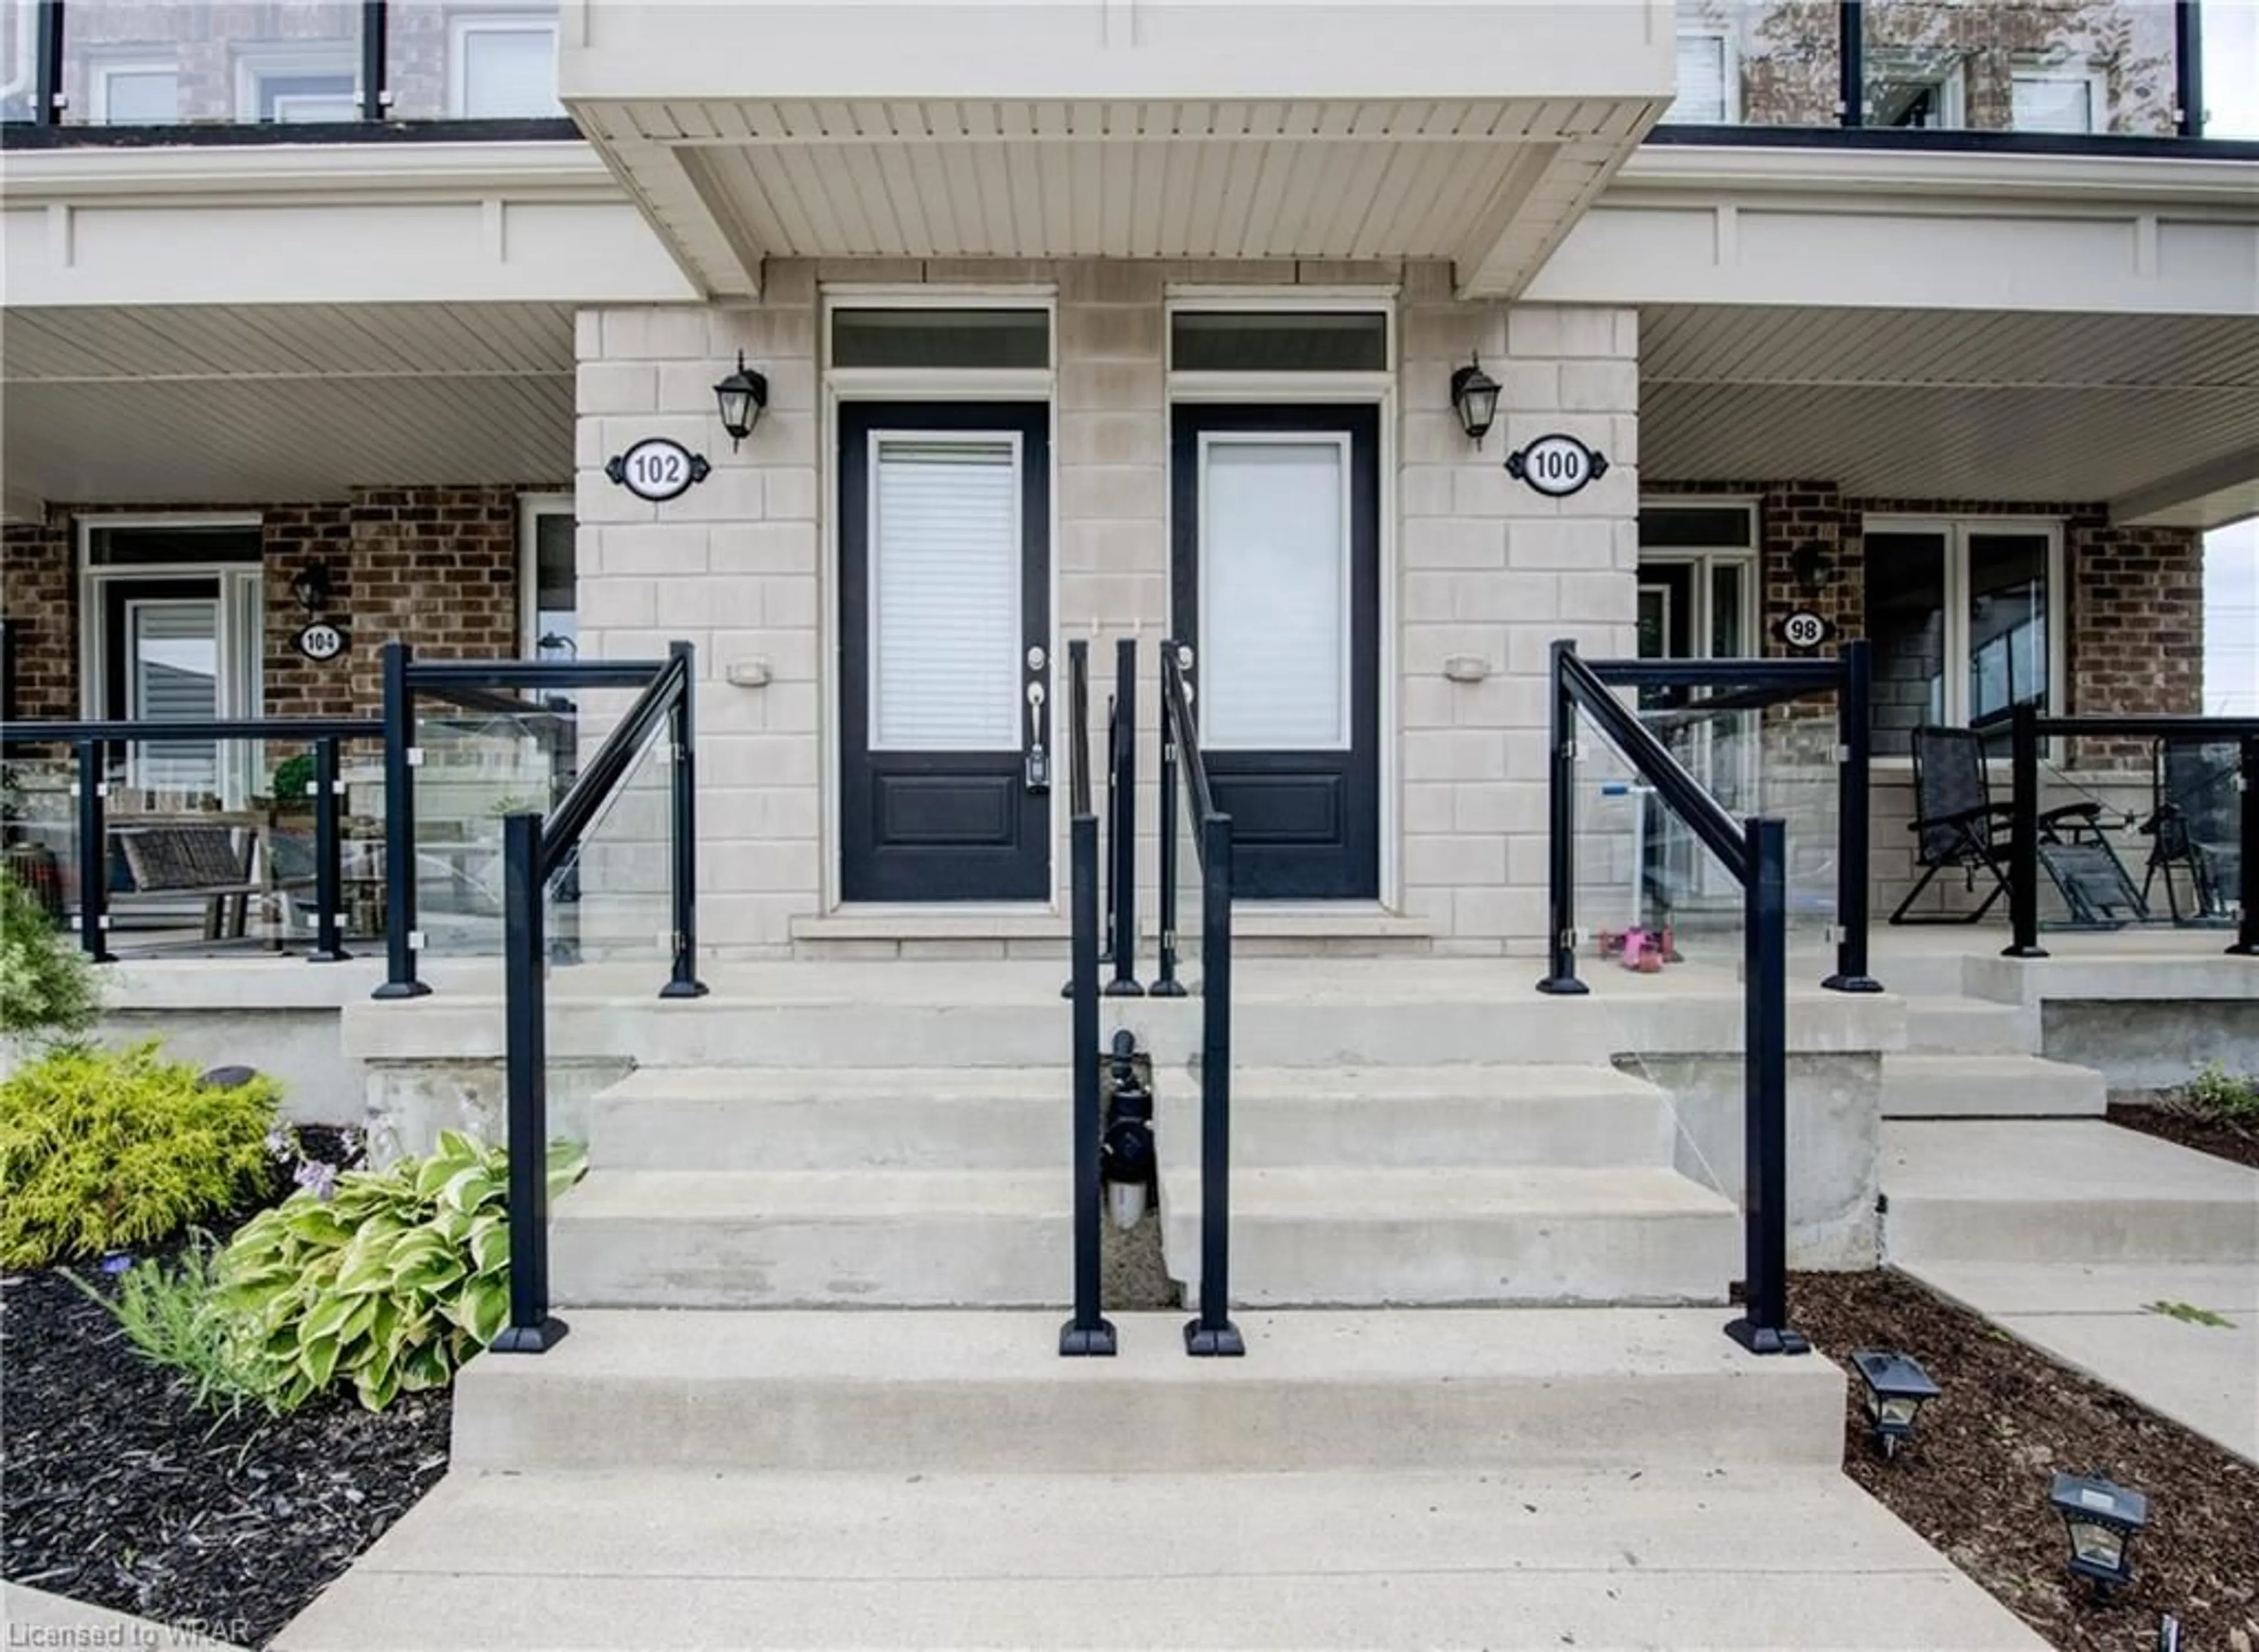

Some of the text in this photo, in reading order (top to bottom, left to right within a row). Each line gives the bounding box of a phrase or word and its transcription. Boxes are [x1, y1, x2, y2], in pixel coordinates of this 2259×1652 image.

[635, 455, 679, 482] 102
[1535, 451, 1578, 478] 100
[308, 632, 334, 650] 104
[1791, 620, 1817, 640] 98
